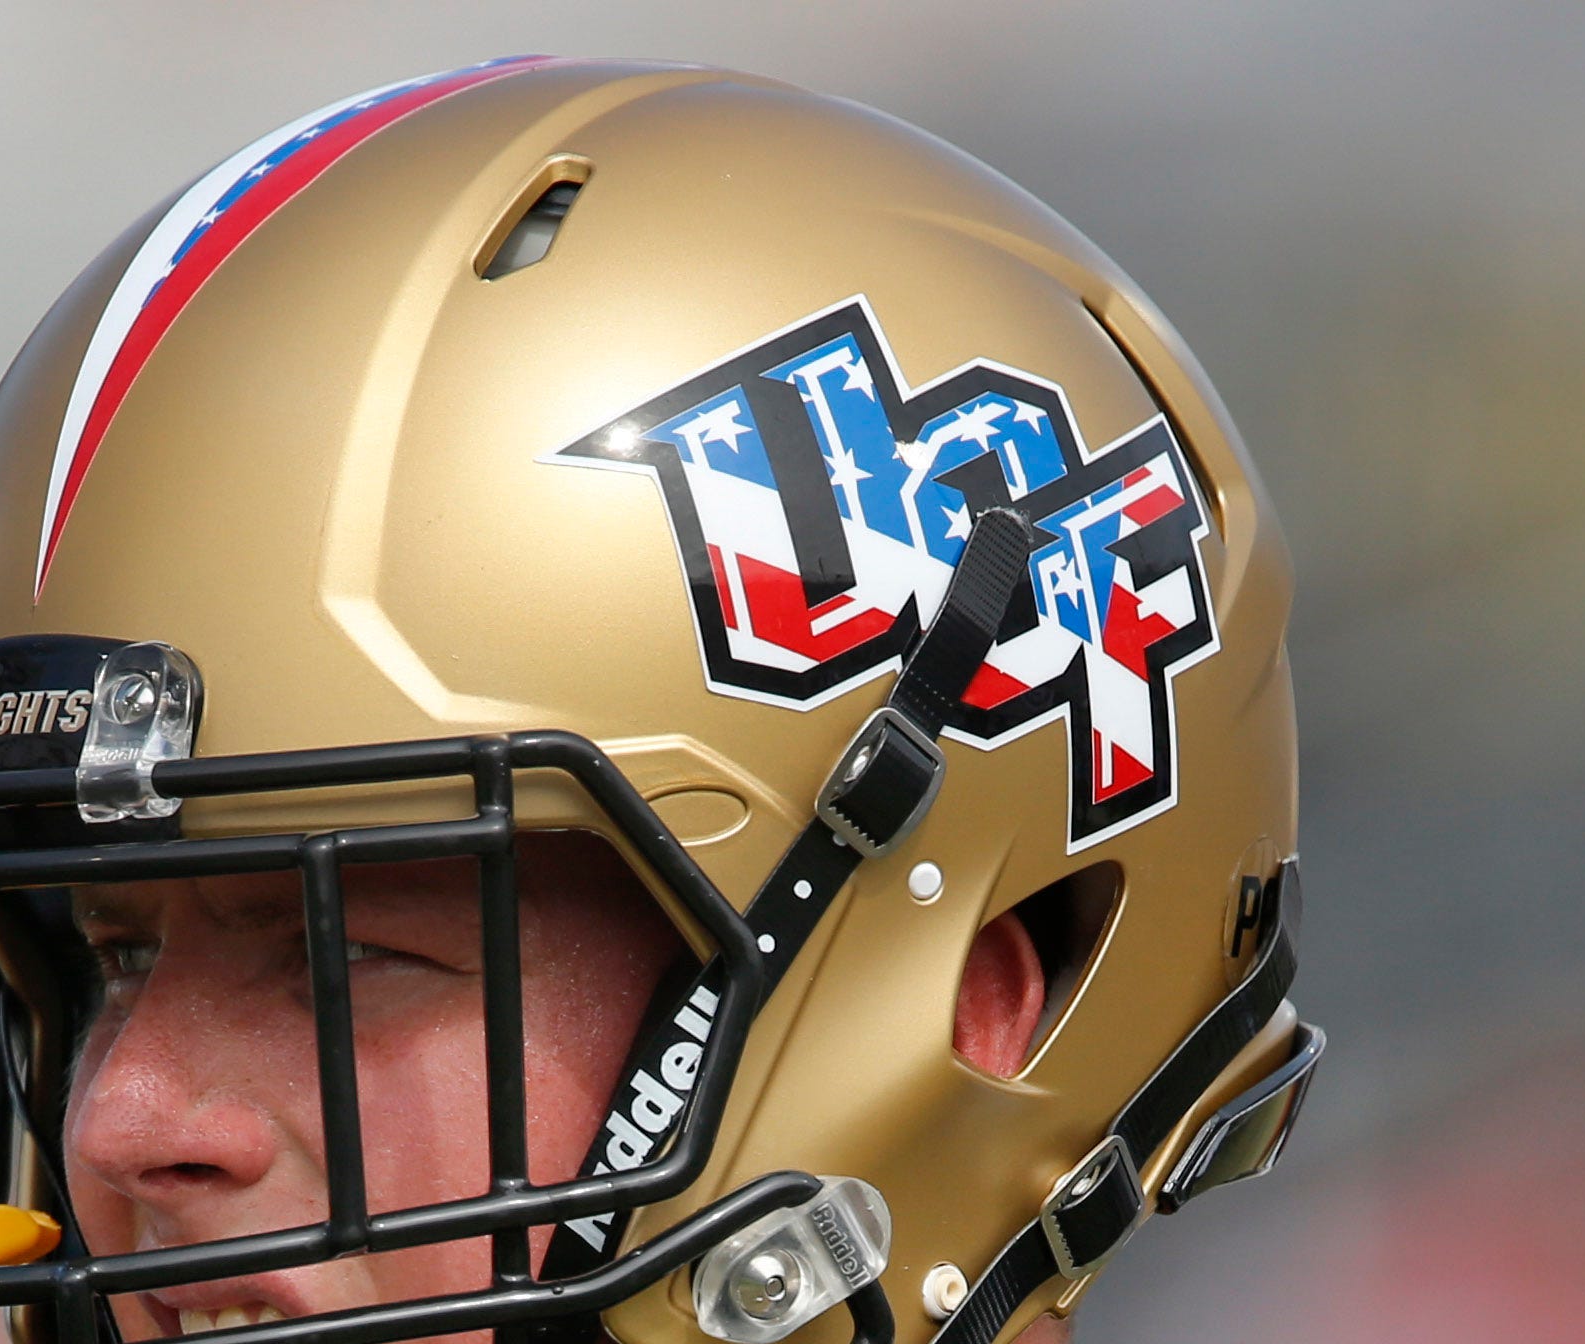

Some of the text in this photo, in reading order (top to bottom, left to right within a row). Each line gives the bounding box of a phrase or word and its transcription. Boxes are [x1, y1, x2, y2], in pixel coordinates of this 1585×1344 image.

[549, 298, 1216, 850] UCF
[564, 984, 720, 1253] ddell
[813, 1201, 871, 1290] Riddell
